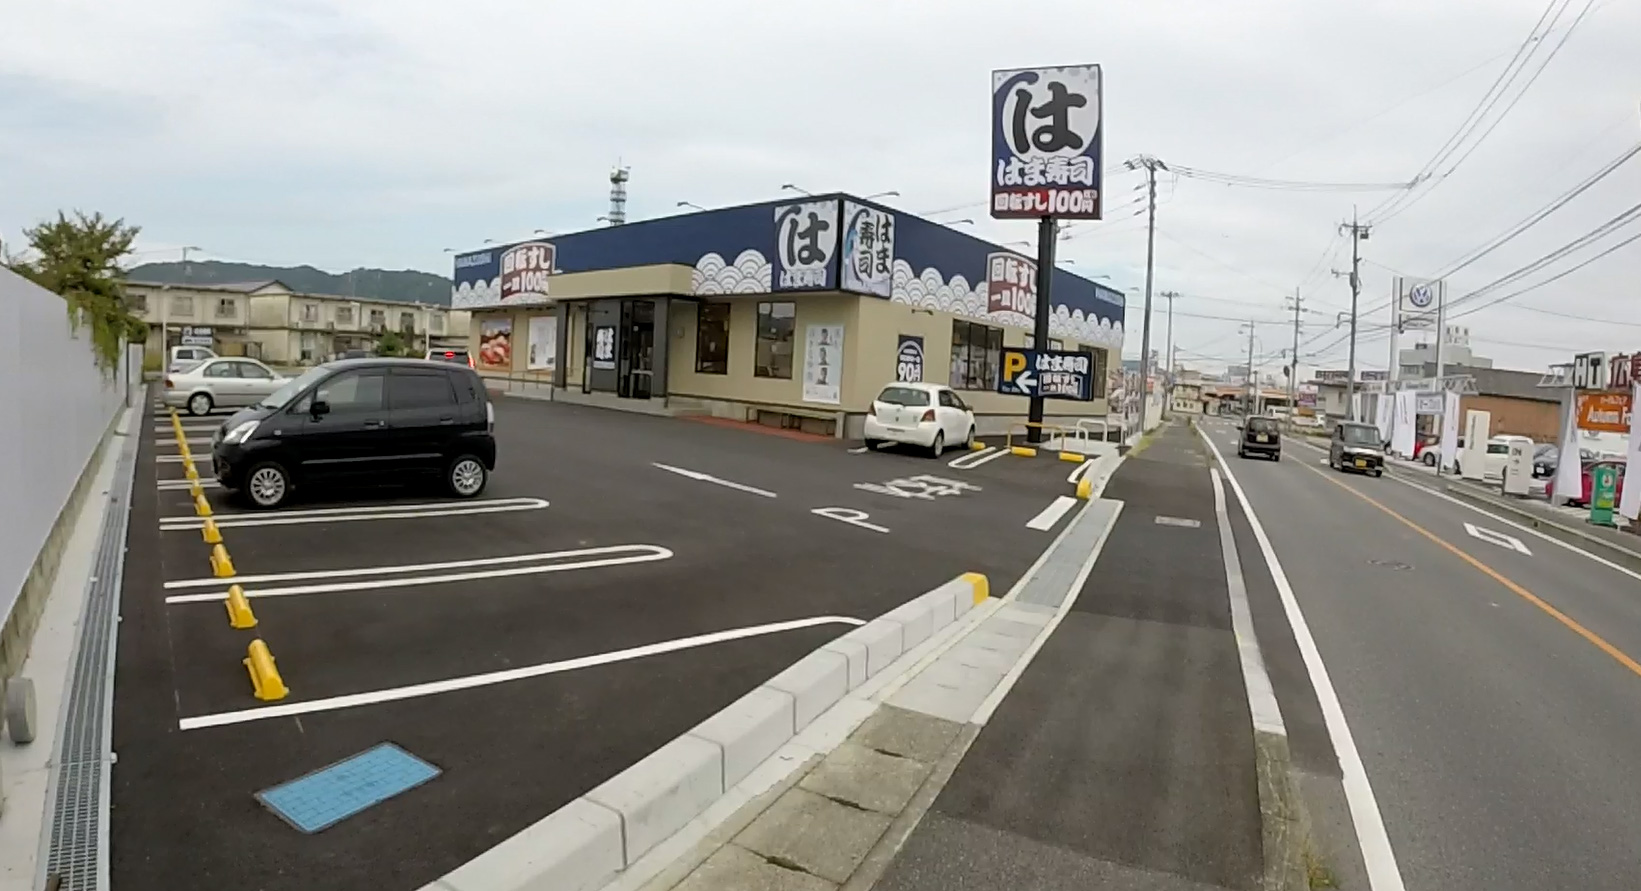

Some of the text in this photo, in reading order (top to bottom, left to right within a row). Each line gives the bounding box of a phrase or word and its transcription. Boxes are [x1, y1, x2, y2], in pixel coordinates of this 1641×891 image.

[1012, 81, 1087, 154] は
[996, 155, 1095, 187] はま寿司
[787, 211, 830, 267] は
[1004, 351, 1027, 382] P
